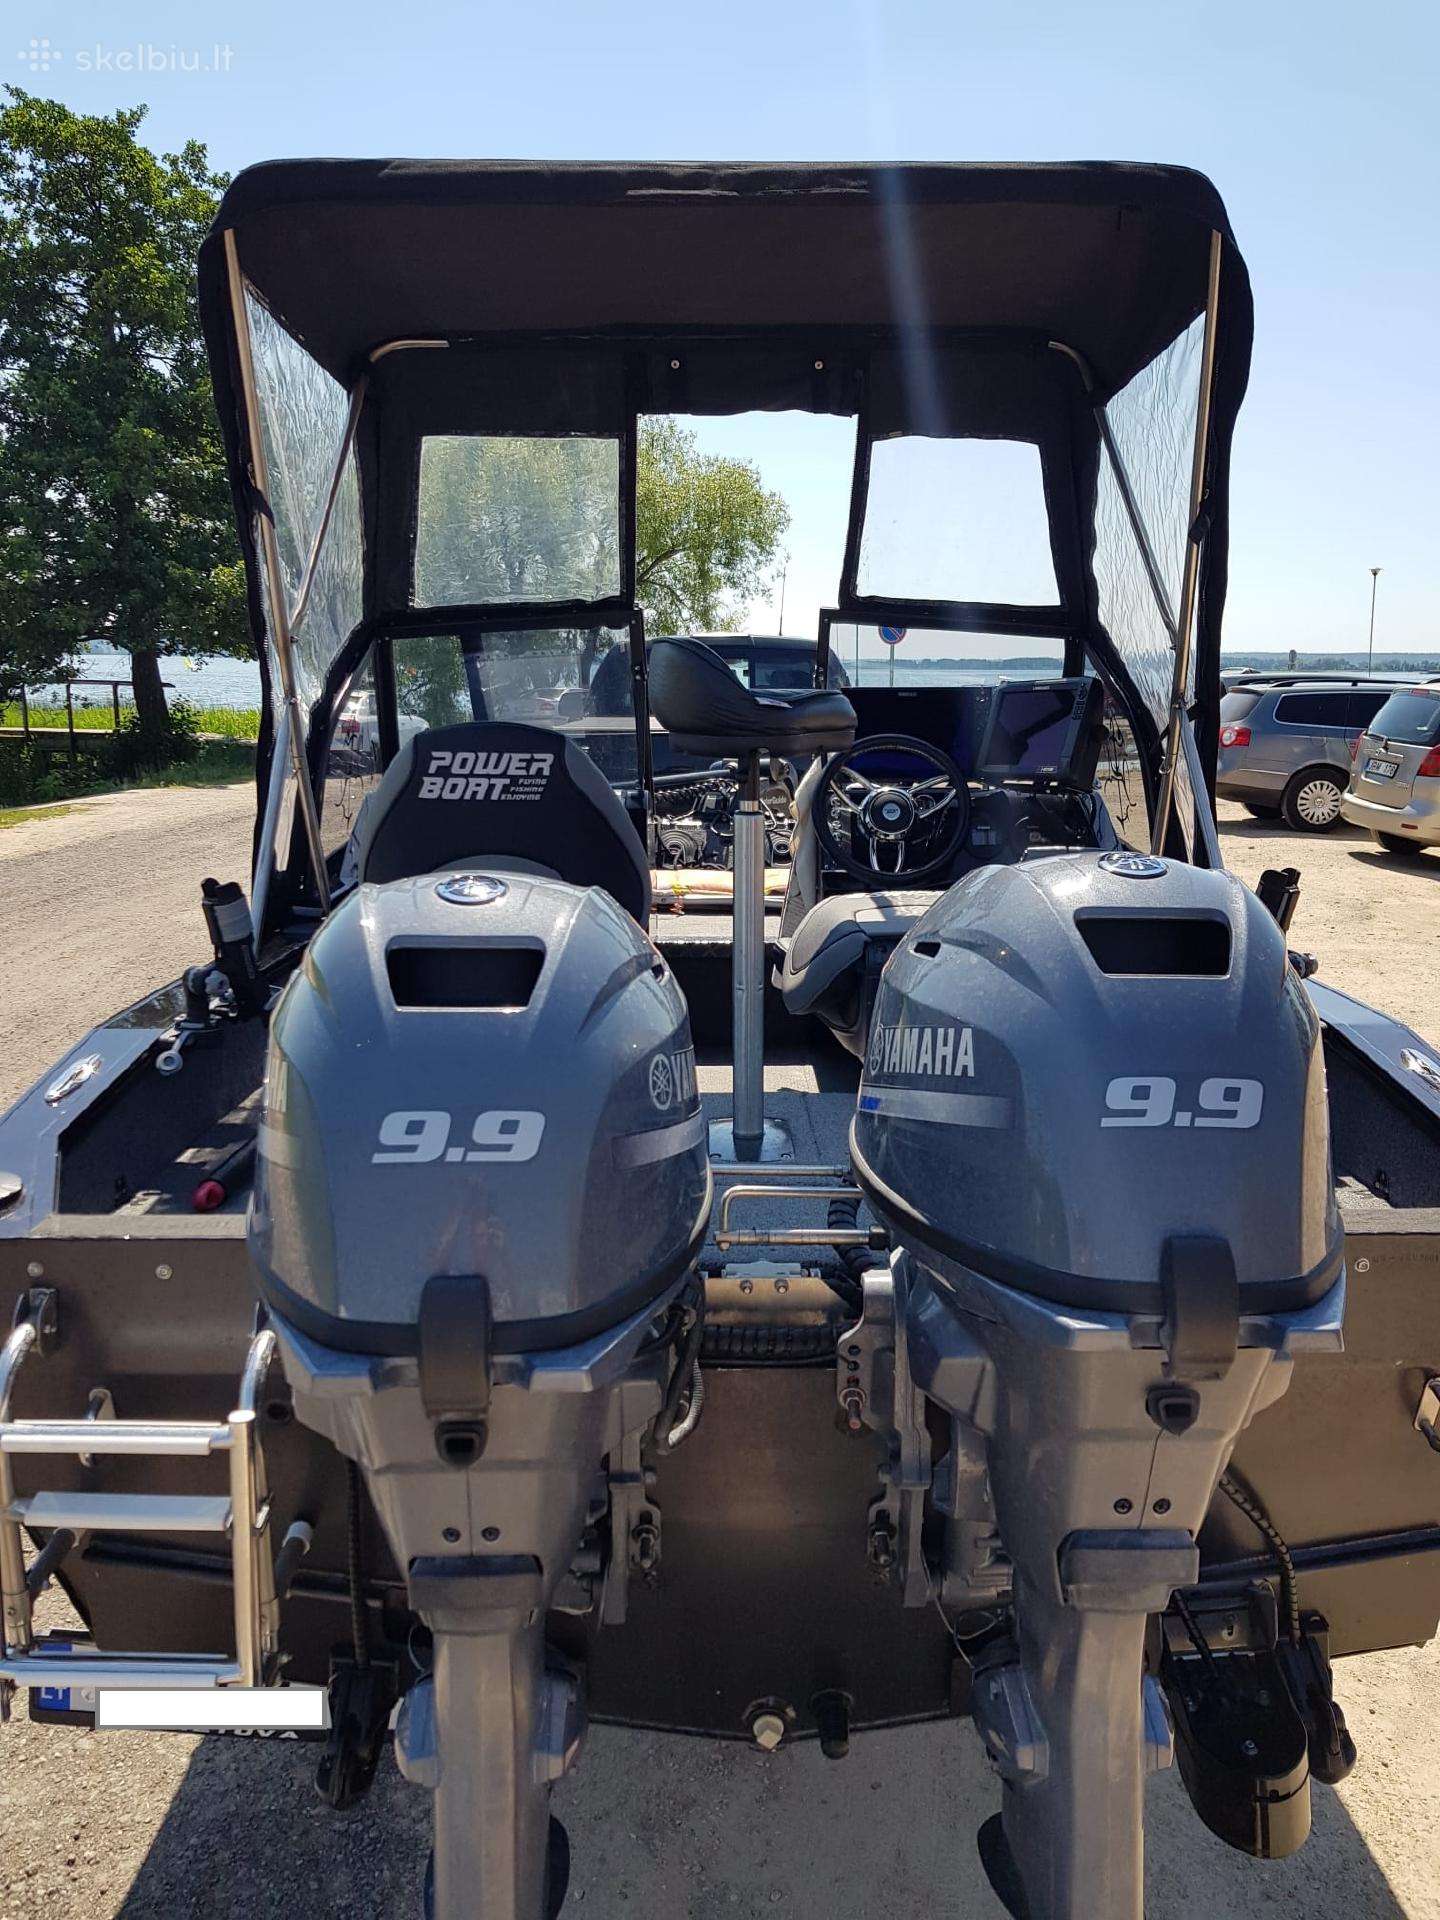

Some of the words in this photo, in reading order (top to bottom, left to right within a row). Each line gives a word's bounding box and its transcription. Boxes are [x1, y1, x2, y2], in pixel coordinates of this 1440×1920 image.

[428, 751, 554, 776] POWER
[418, 777, 510, 801] BOAT
[883, 1027, 975, 1077] YAMAHA
[1100, 1076, 1264, 1129] 9.9
[372, 1110, 546, 1164] 9.9
